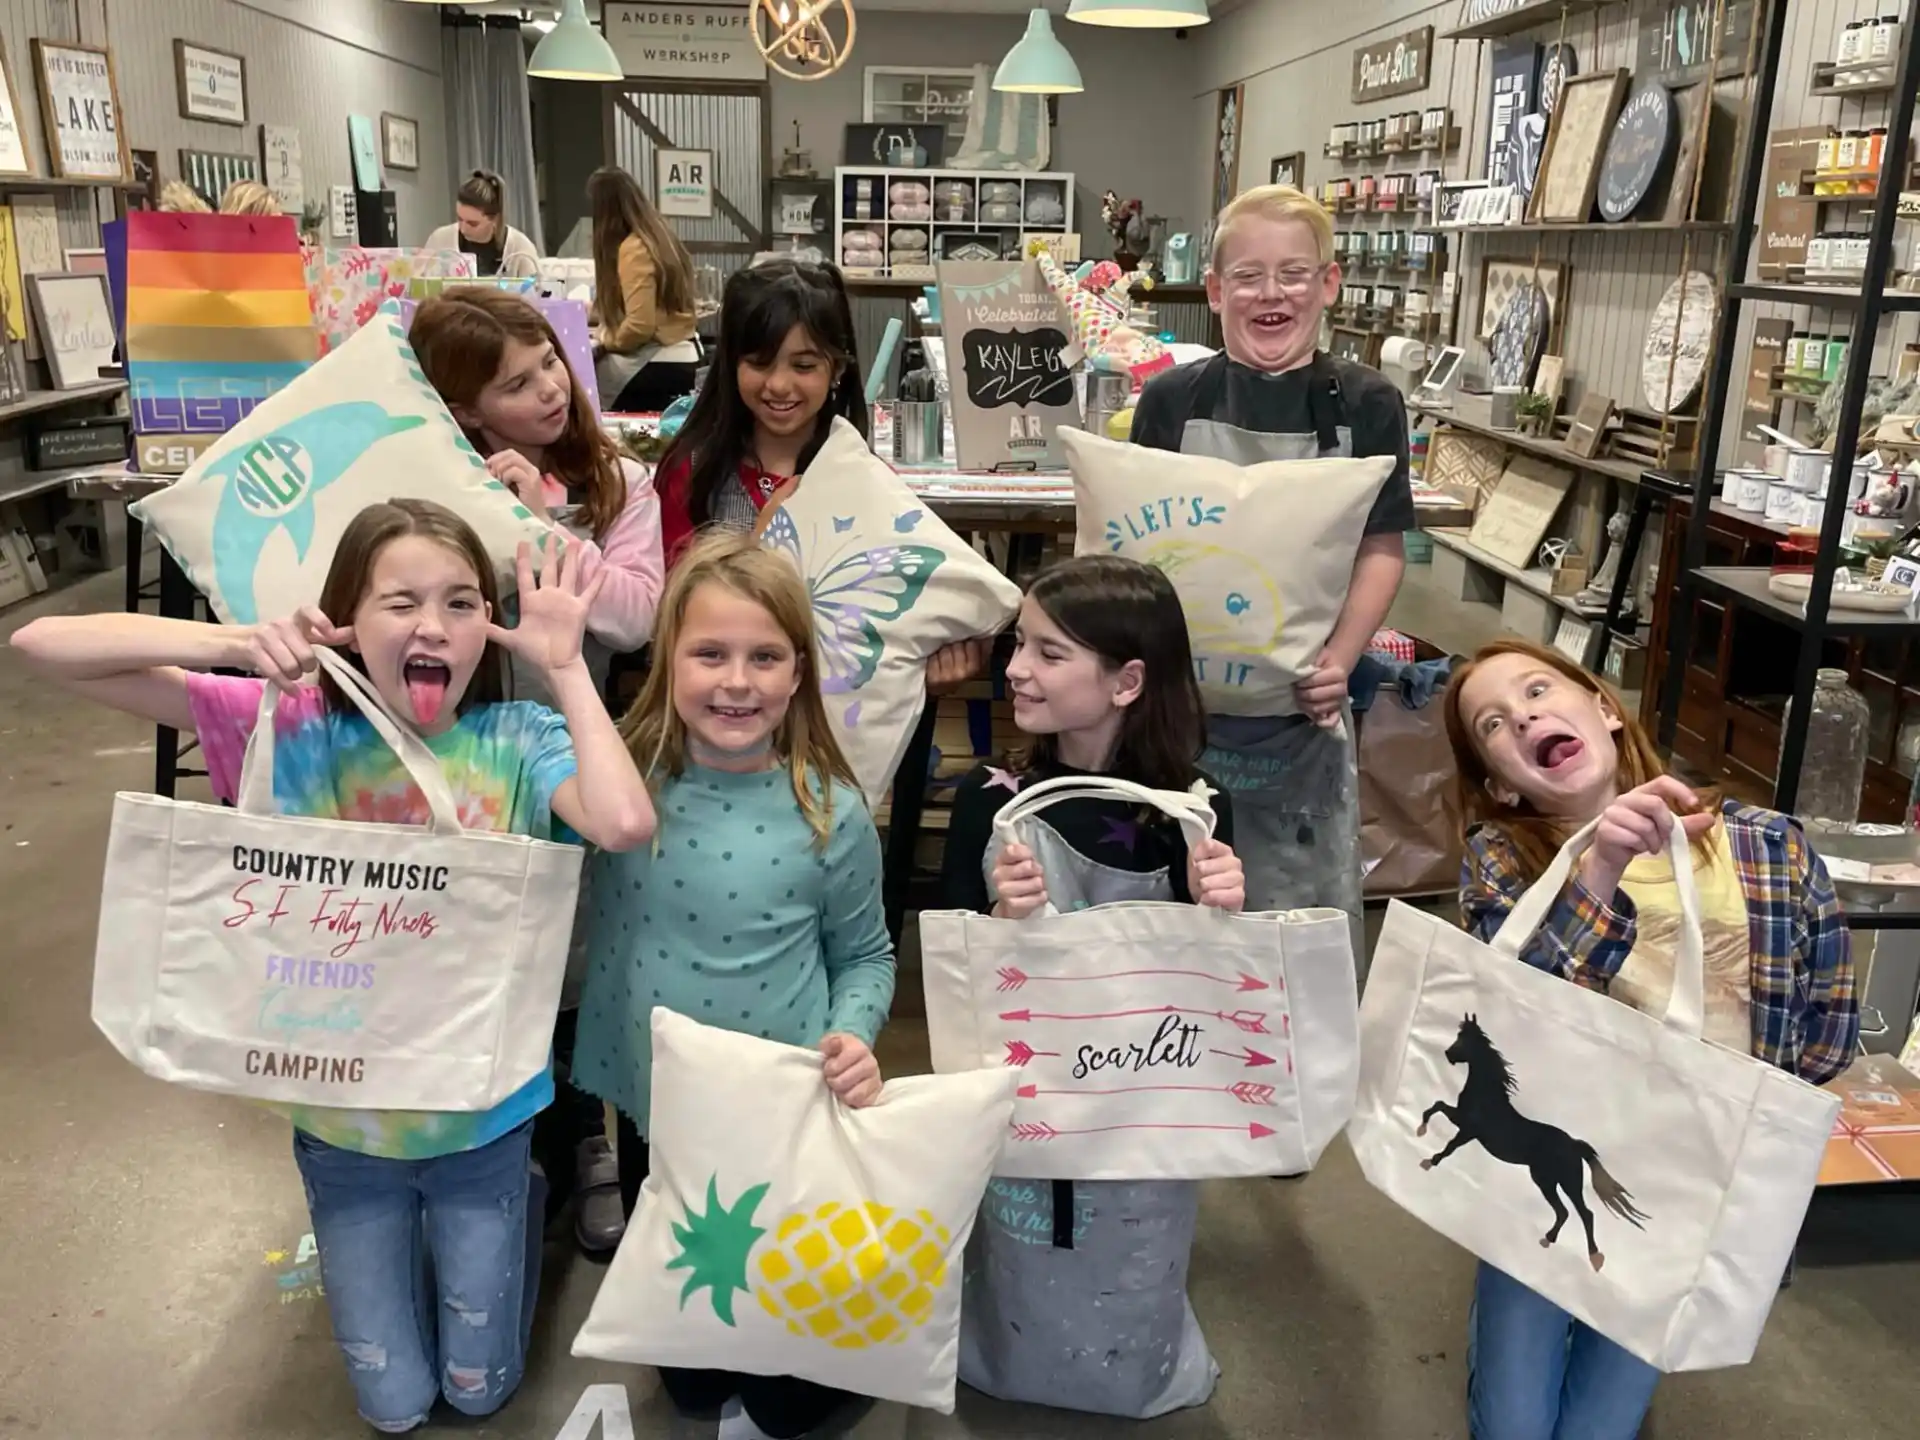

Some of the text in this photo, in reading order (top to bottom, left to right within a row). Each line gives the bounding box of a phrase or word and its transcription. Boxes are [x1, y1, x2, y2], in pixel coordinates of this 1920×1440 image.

[621, 11, 751, 27] ANDERS RUFF
[643, 48, 731, 64] WORKSHOP
[1359, 51, 1391, 92] Paint
[52, 94, 115, 132] LAKE
[975, 305, 1058, 323] Celebrated
[977, 343, 1065, 384] KAYLEIG
[1123, 496, 1203, 540] LET'S
[1224, 660, 1257, 686] IT
[232, 845, 449, 892] COUNTRY MUSIC
[265, 954, 376, 990] FRIENDS
[1072, 1014, 1206, 1079] scarlett
[245, 1049, 365, 1083] CAMPING
